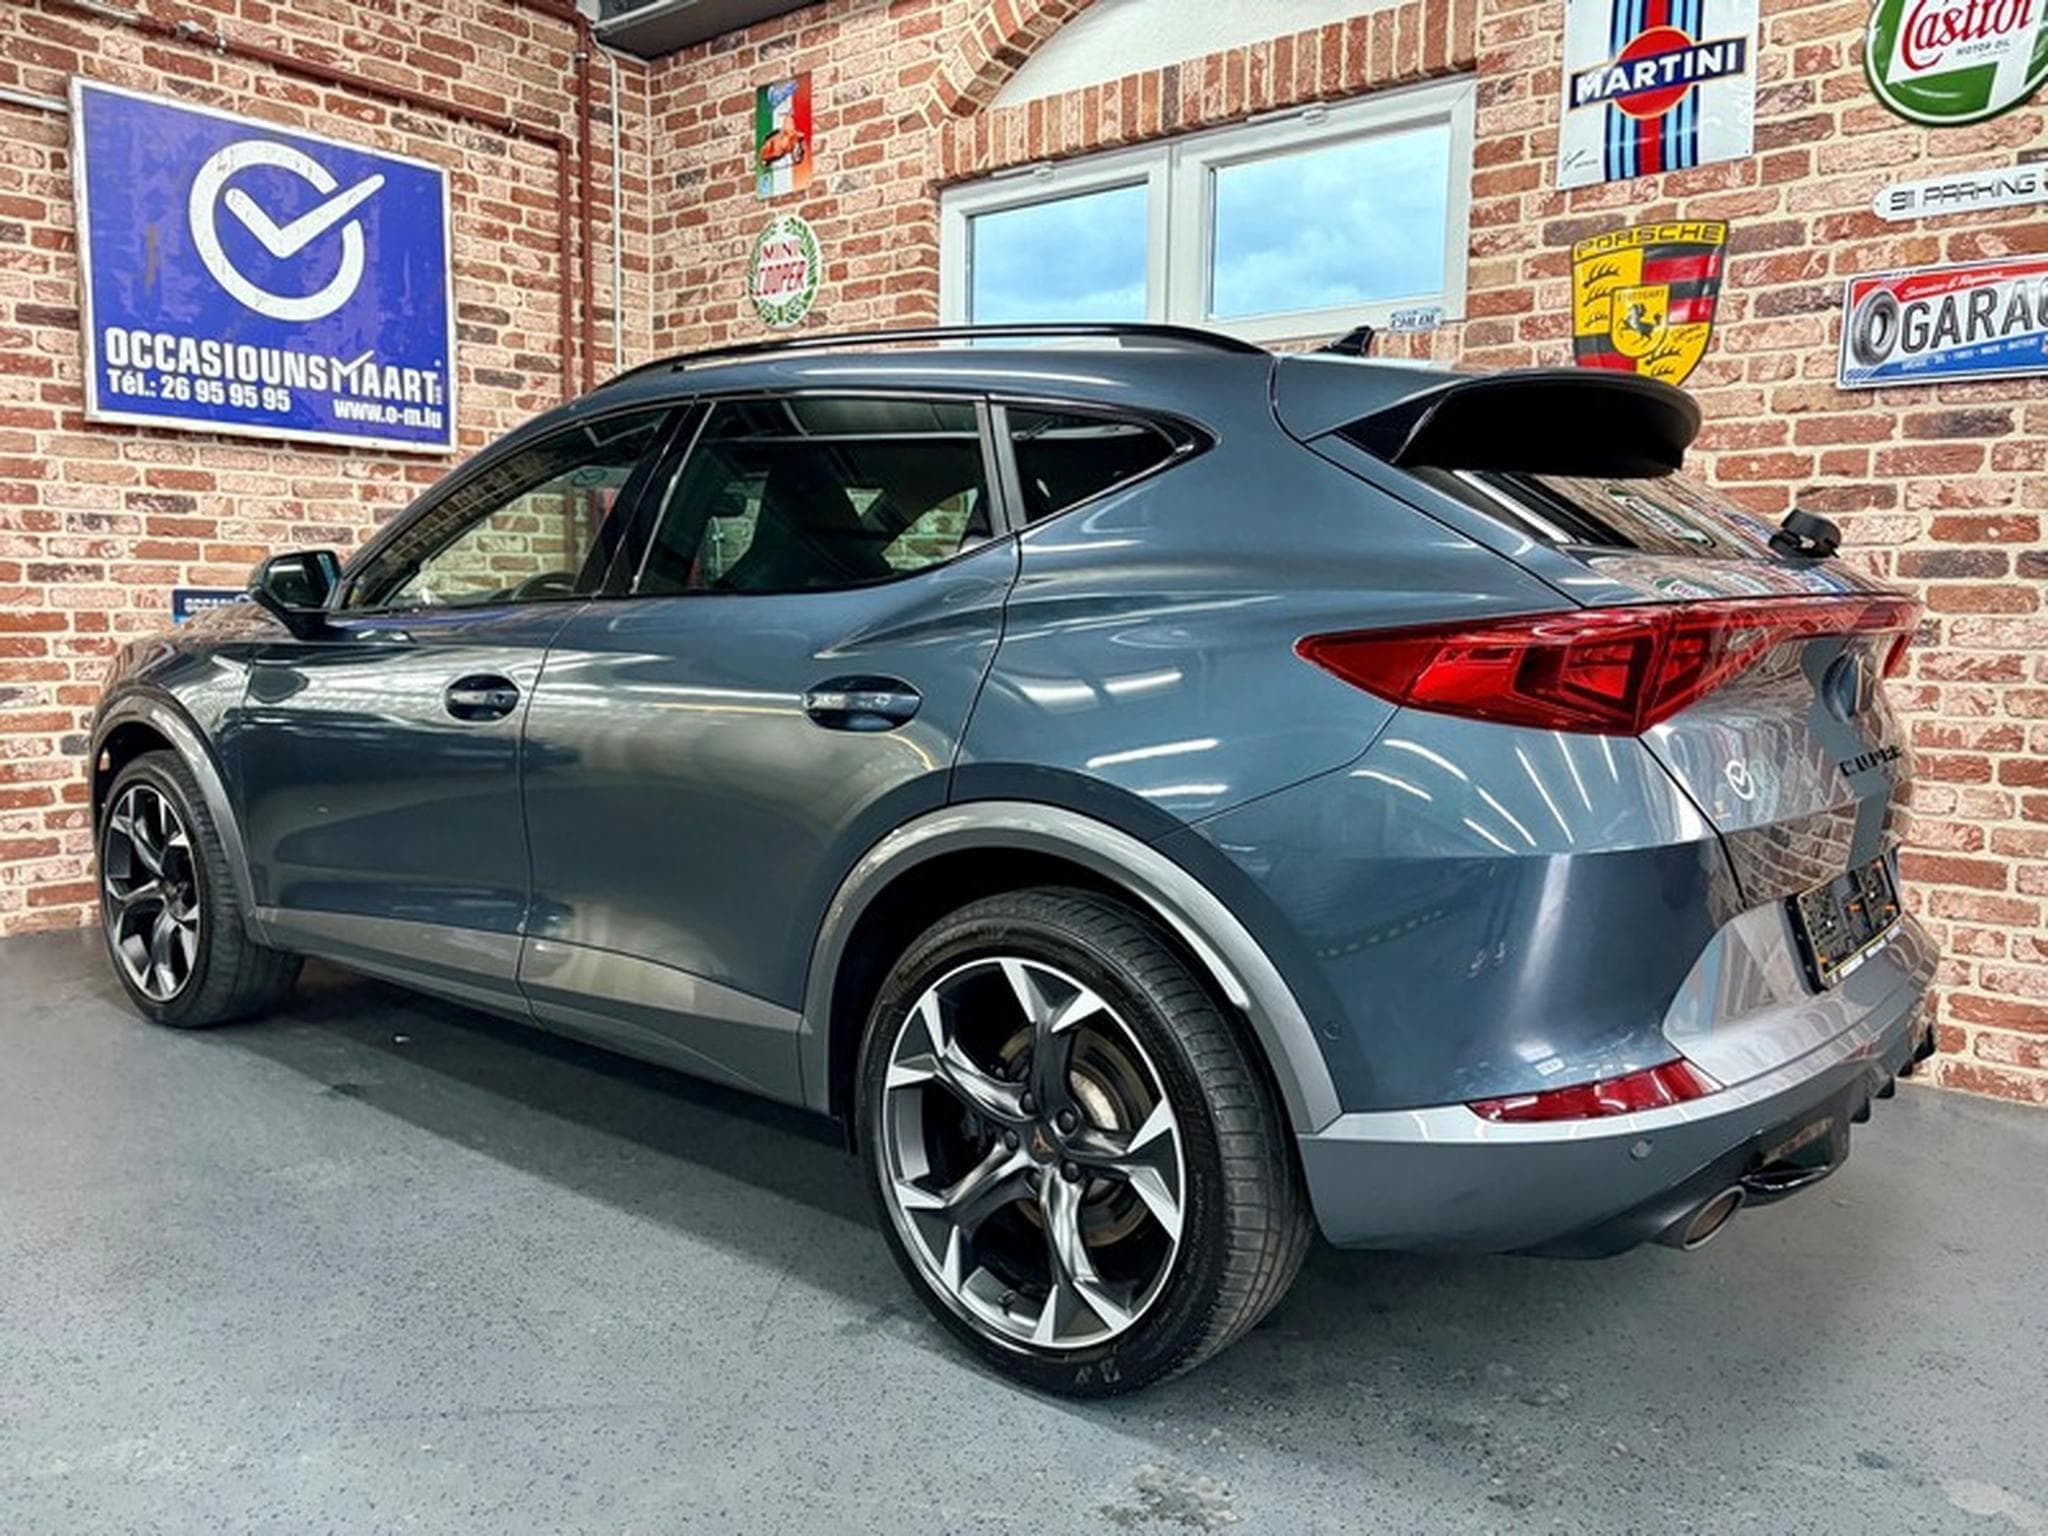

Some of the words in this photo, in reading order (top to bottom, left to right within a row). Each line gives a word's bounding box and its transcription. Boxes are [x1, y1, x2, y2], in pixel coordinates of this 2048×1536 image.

[1575, 42, 1737, 105] MARTINI
[1922, 173, 2037, 208] PARKING
[1577, 224, 1722, 258] PORSCHE
[106, 368, 157, 397] Tél.:
[160, 375, 191, 401] 26
[194, 379, 225, 405] 95
[229, 382, 259, 409] 95
[262, 386, 291, 413] 95
[333, 399, 443, 429] www.o-m.lu
